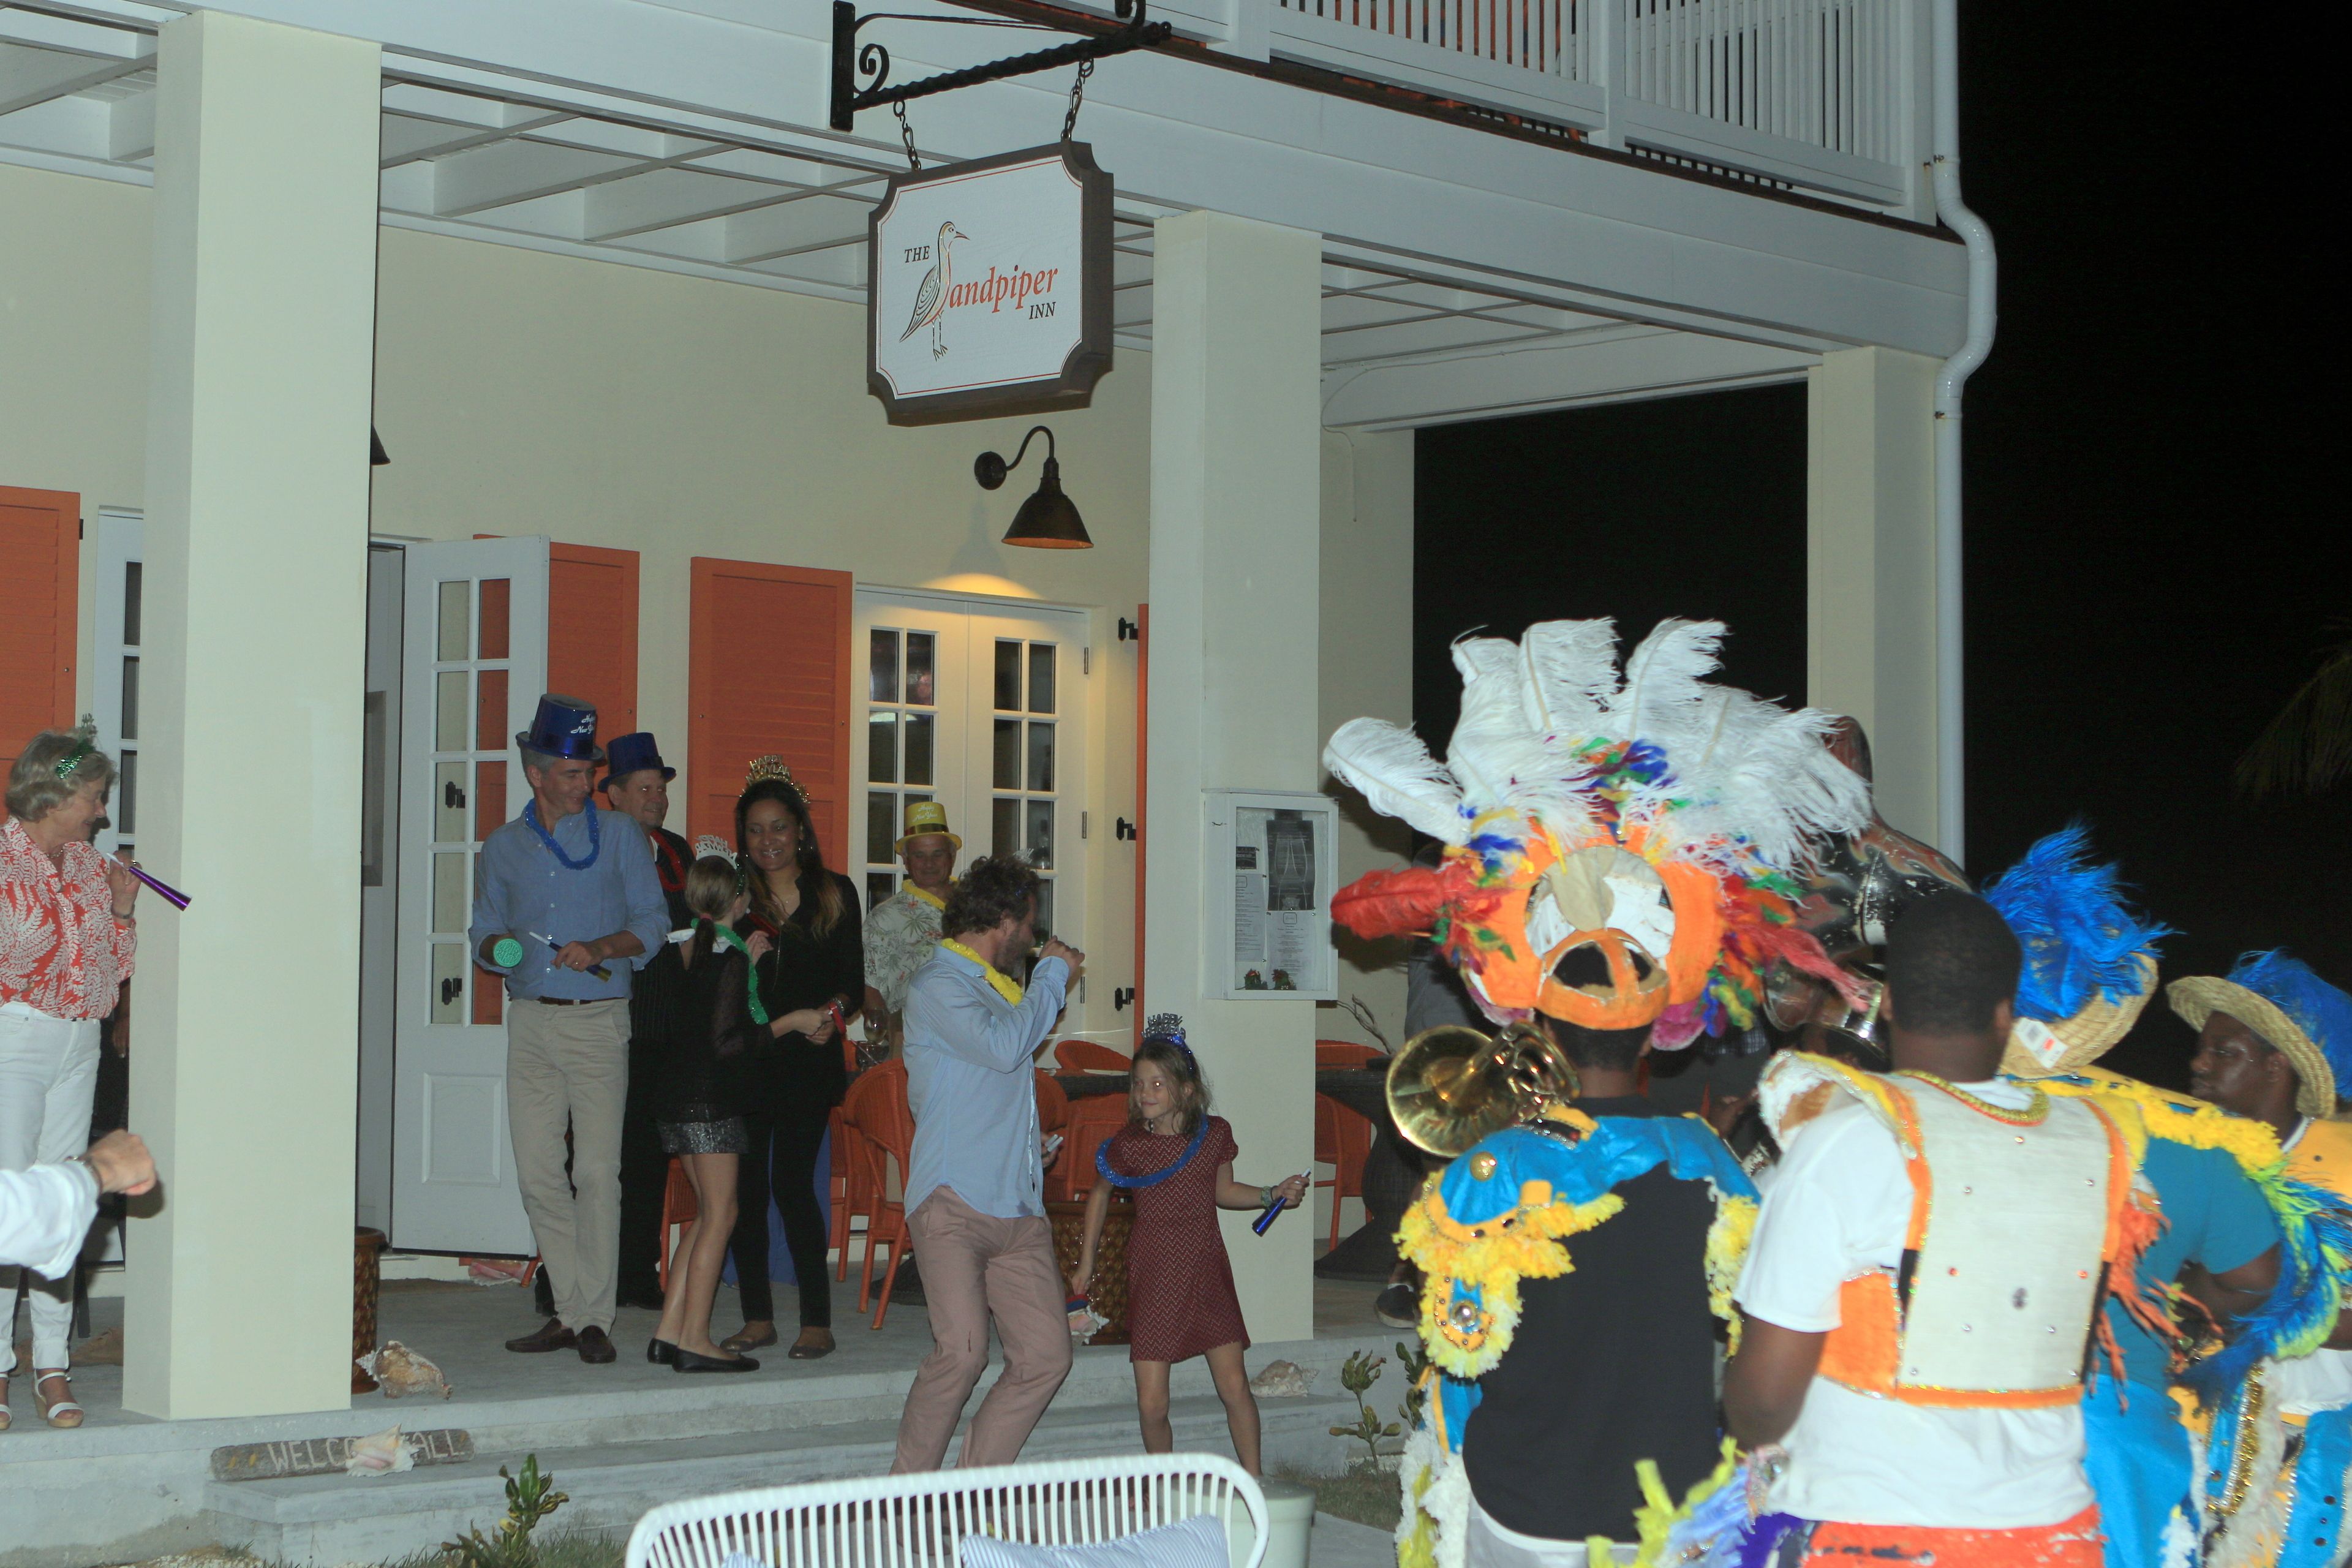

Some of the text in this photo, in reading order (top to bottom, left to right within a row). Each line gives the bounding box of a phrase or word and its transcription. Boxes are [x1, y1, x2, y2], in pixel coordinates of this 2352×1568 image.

[904, 245, 930, 263] THE
[1029, 302, 1056, 320] INN
[267, 1430, 465, 1471] WELCO ALL
